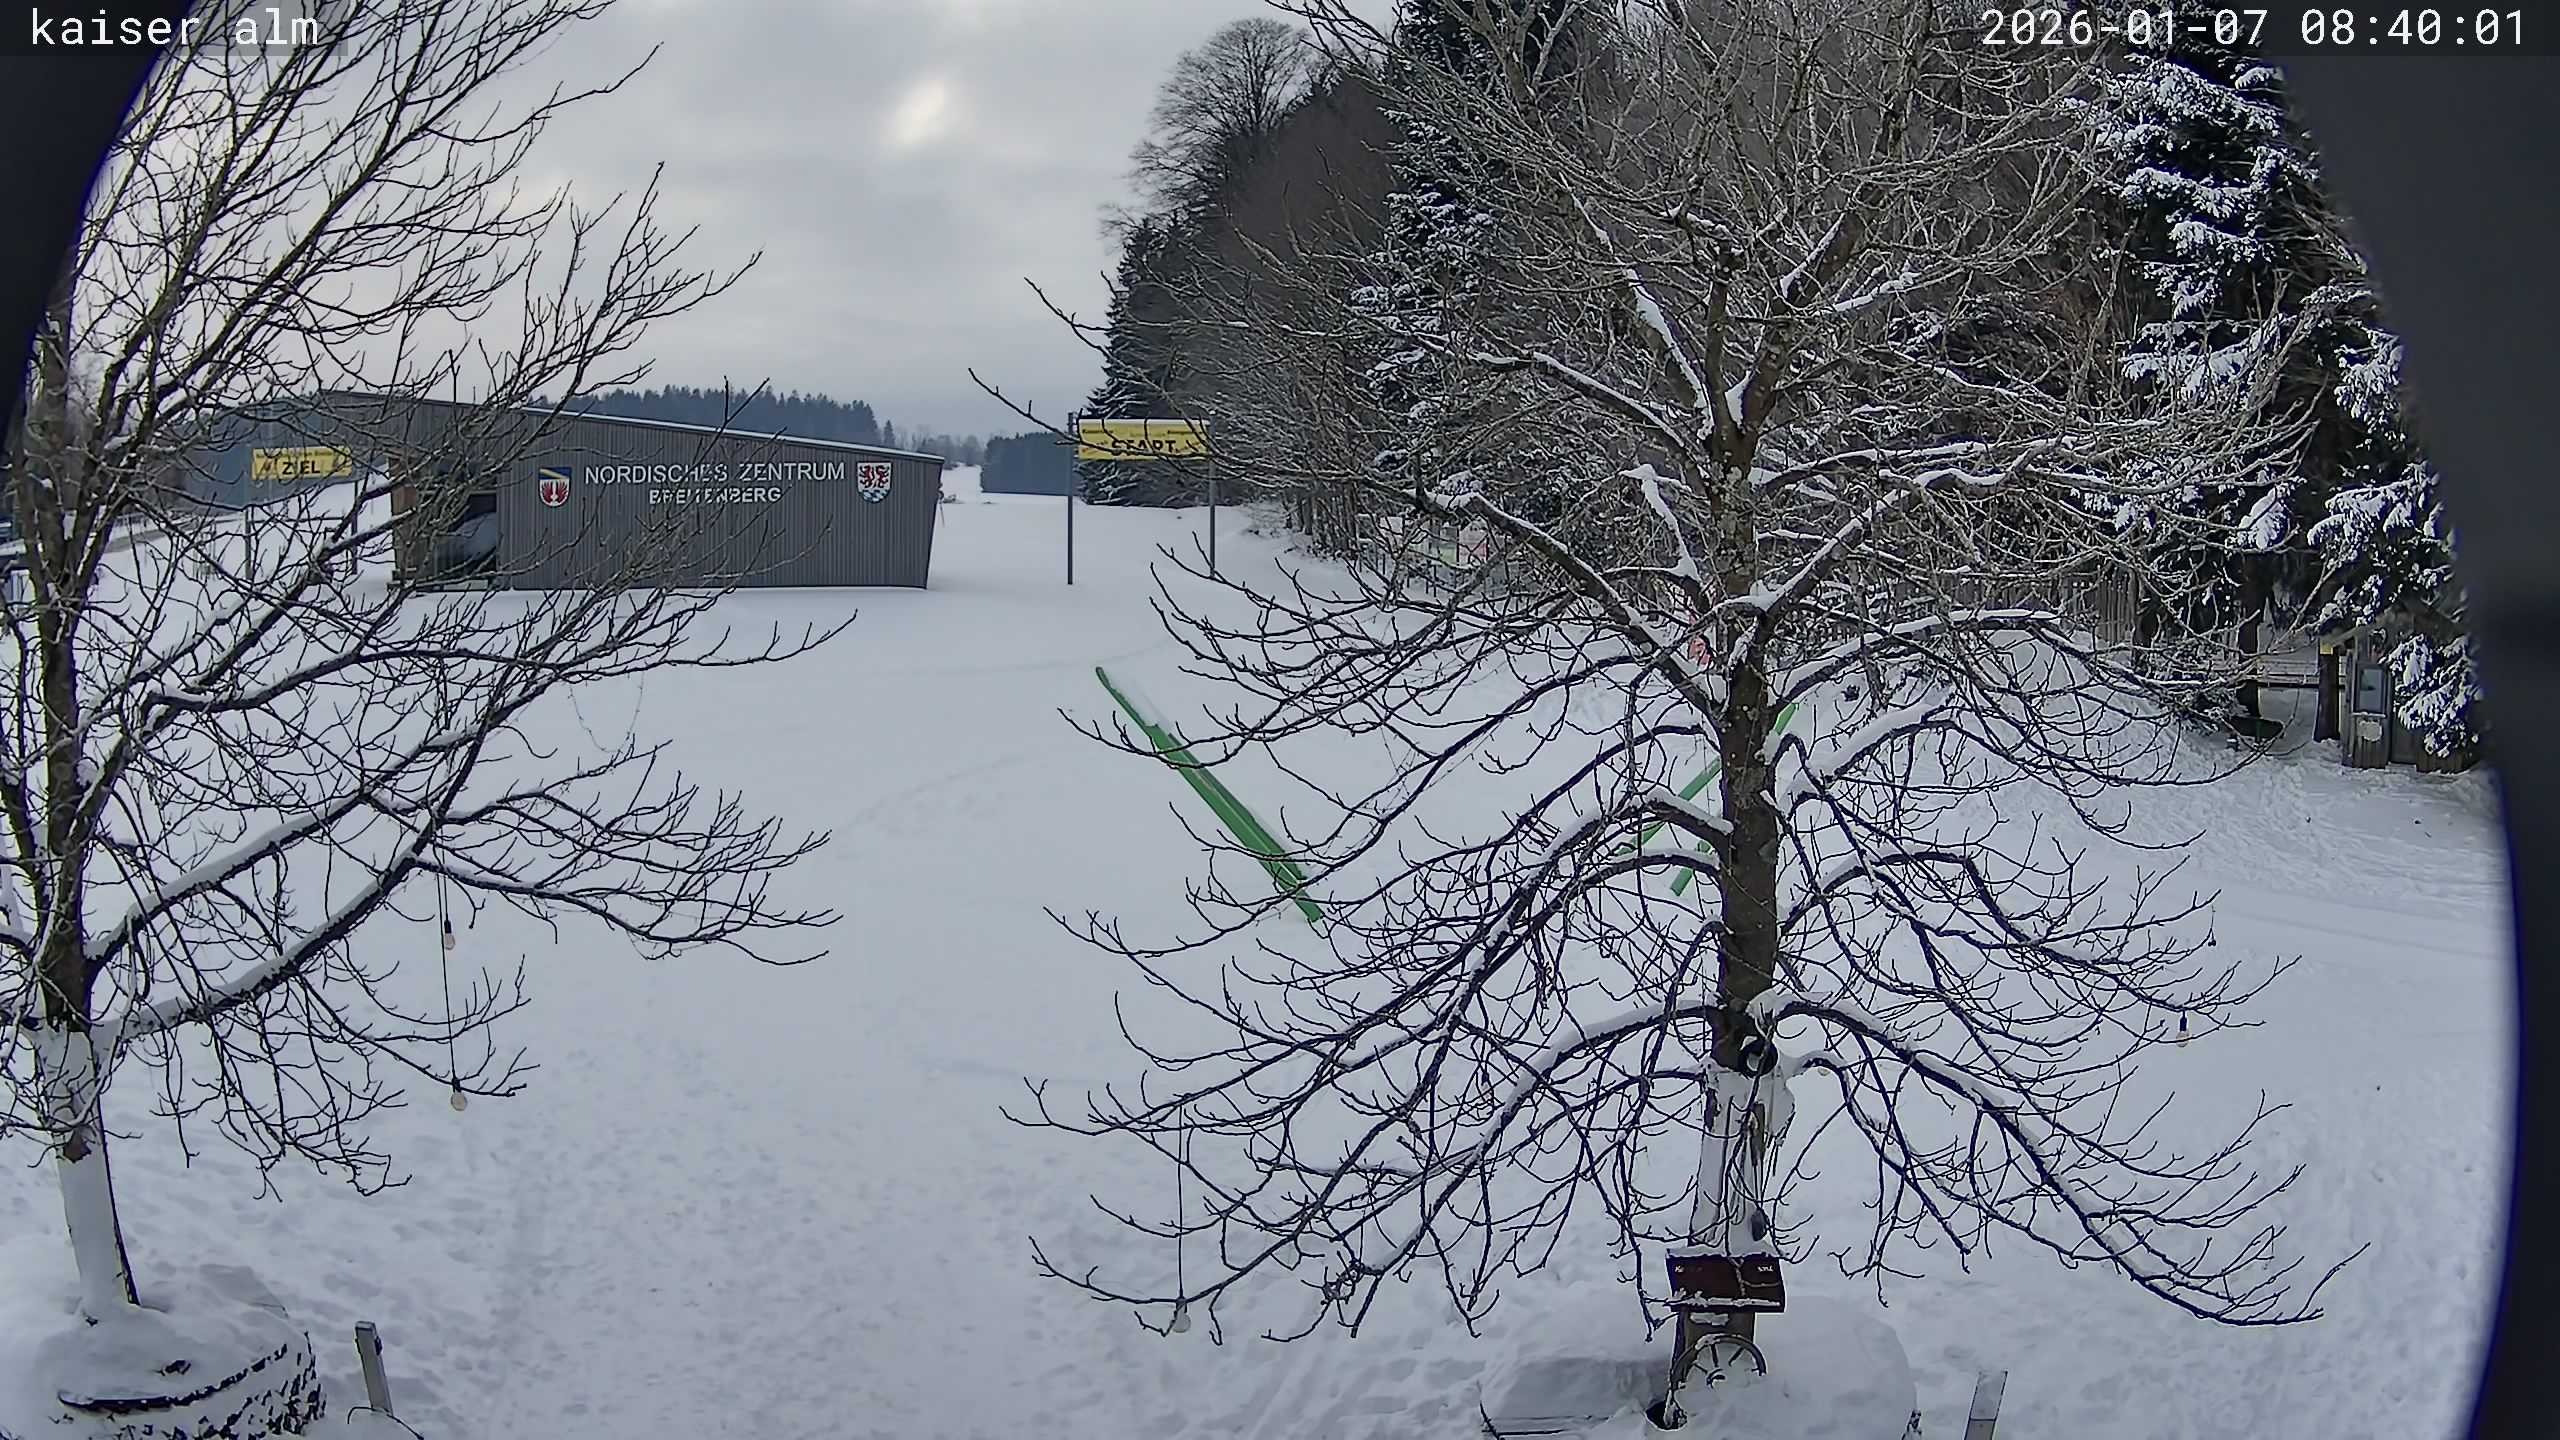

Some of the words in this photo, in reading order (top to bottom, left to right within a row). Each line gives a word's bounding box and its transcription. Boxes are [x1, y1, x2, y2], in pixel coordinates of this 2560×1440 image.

[282, 460, 321, 474] ZIEL
[585, 464, 729, 485] NORDISCHES
[740, 461, 846, 481] ZENTRUM
